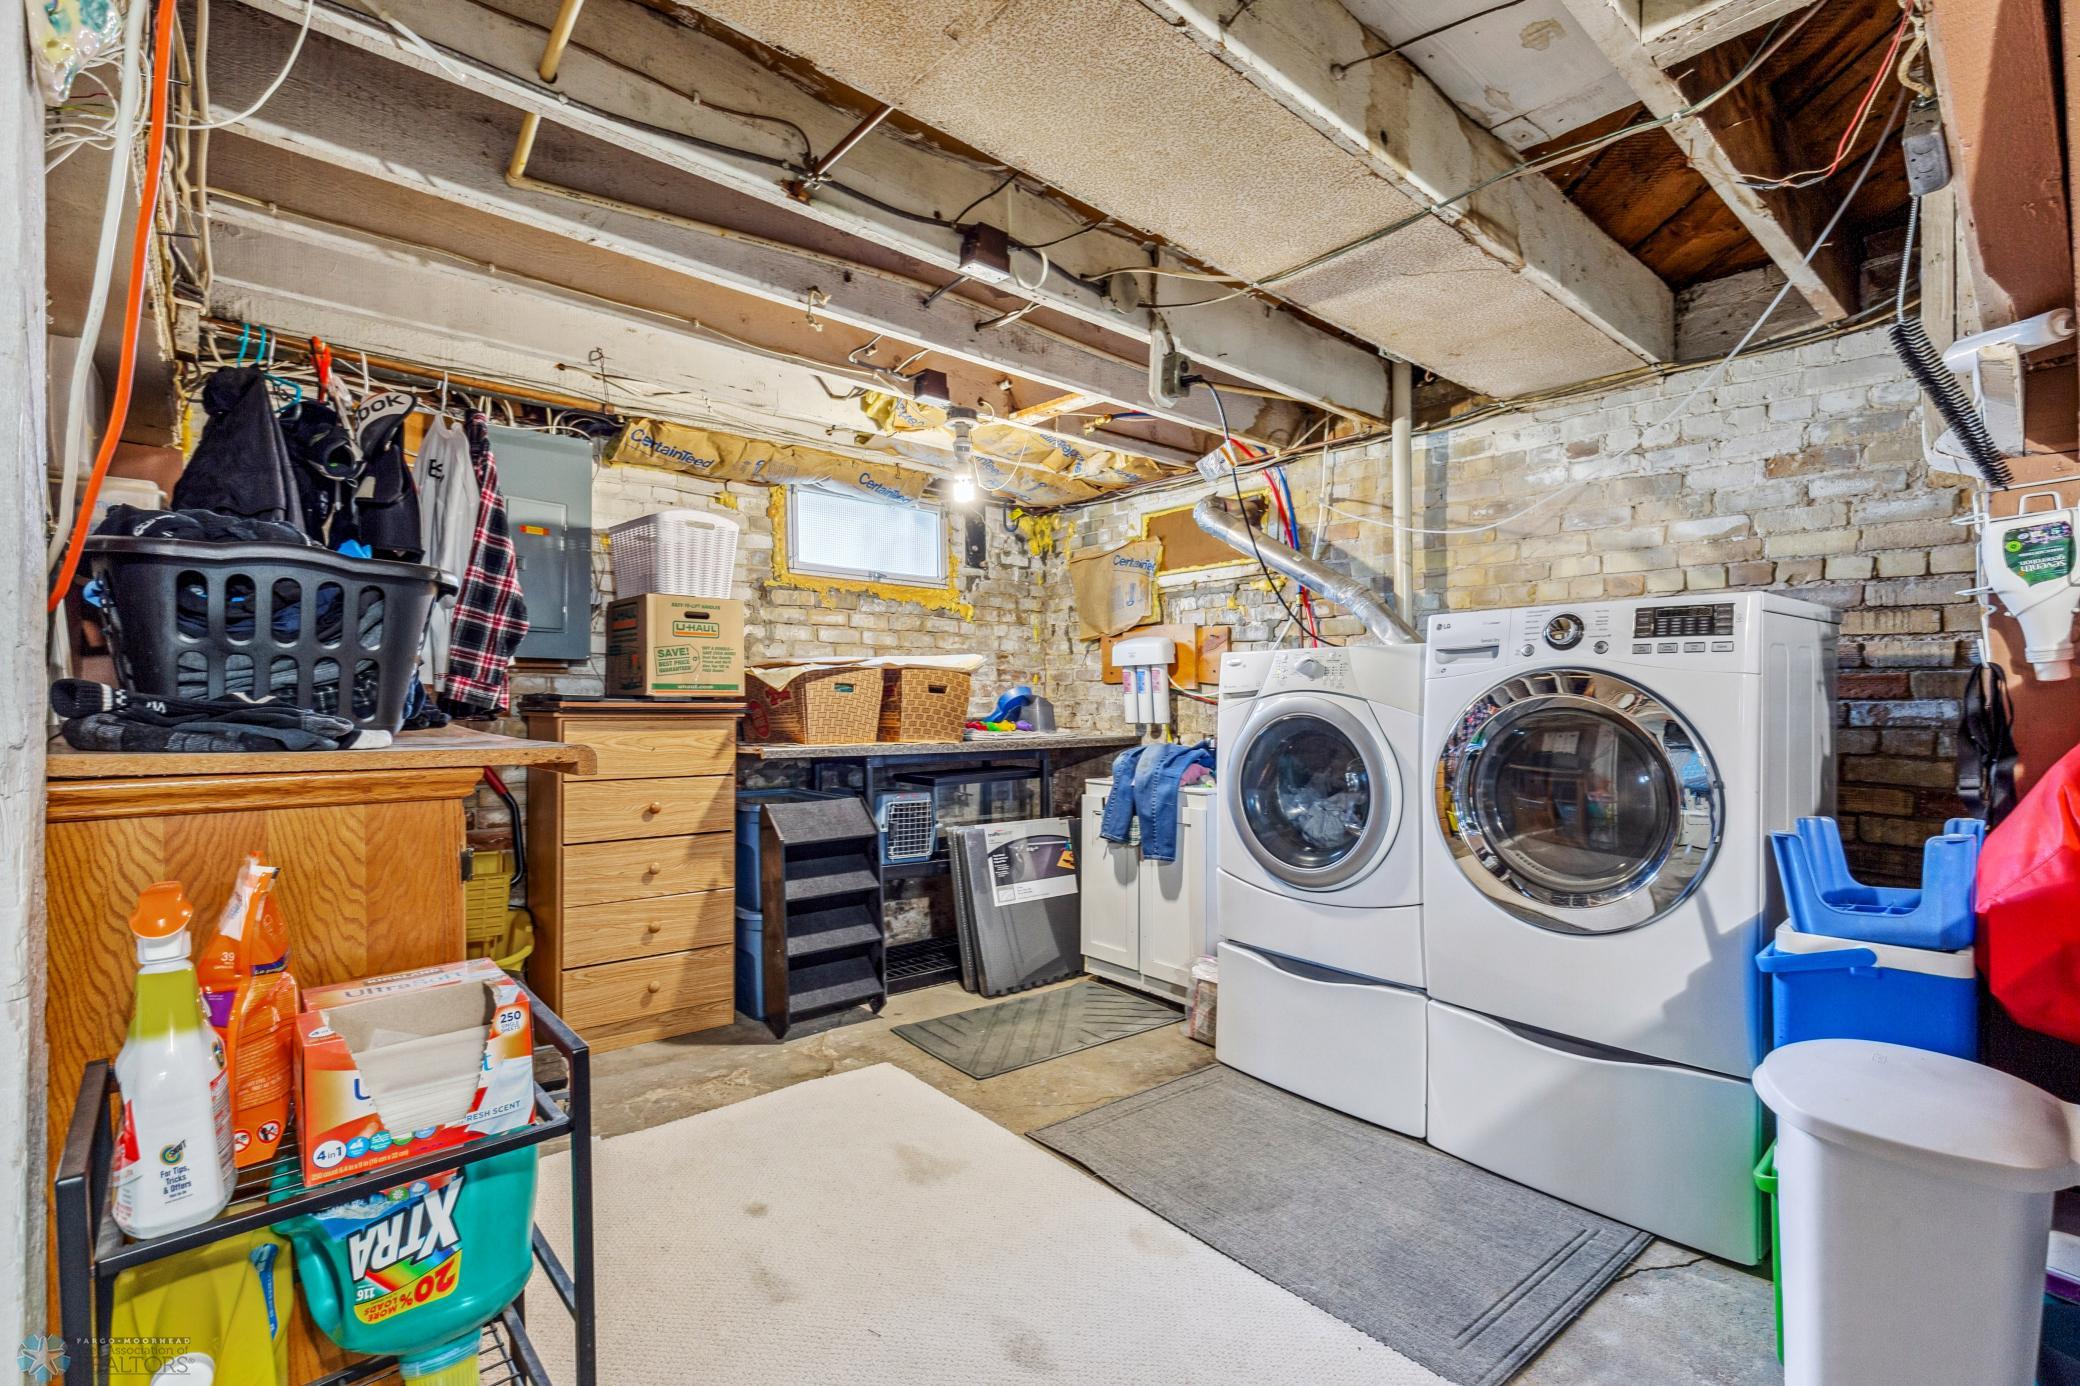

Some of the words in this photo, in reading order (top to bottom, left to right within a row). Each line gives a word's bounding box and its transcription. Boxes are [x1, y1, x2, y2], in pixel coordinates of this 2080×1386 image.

[630, 428, 715, 468] CertainTeed
[675, 623, 717, 633] U-HAUL
[657, 647, 690, 658] SAVE!
[220, 951, 235, 961] 39
[500, 1010, 521, 1023] 250
[492, 1100, 521, 1115] SCENT
[160, 1170, 171, 1178] For
[165, 1174, 187, 1185] Tricks
[163, 1187, 169, 1195] &
[170, 1181, 192, 1193] Offers
[349, 1175, 464, 1282] XTRA
[400, 1258, 457, 1309] 20%
[355, 1287, 376, 1302] 116
[363, 1298, 398, 1315] LOADS
[367, 1305, 398, 1322] MORE
